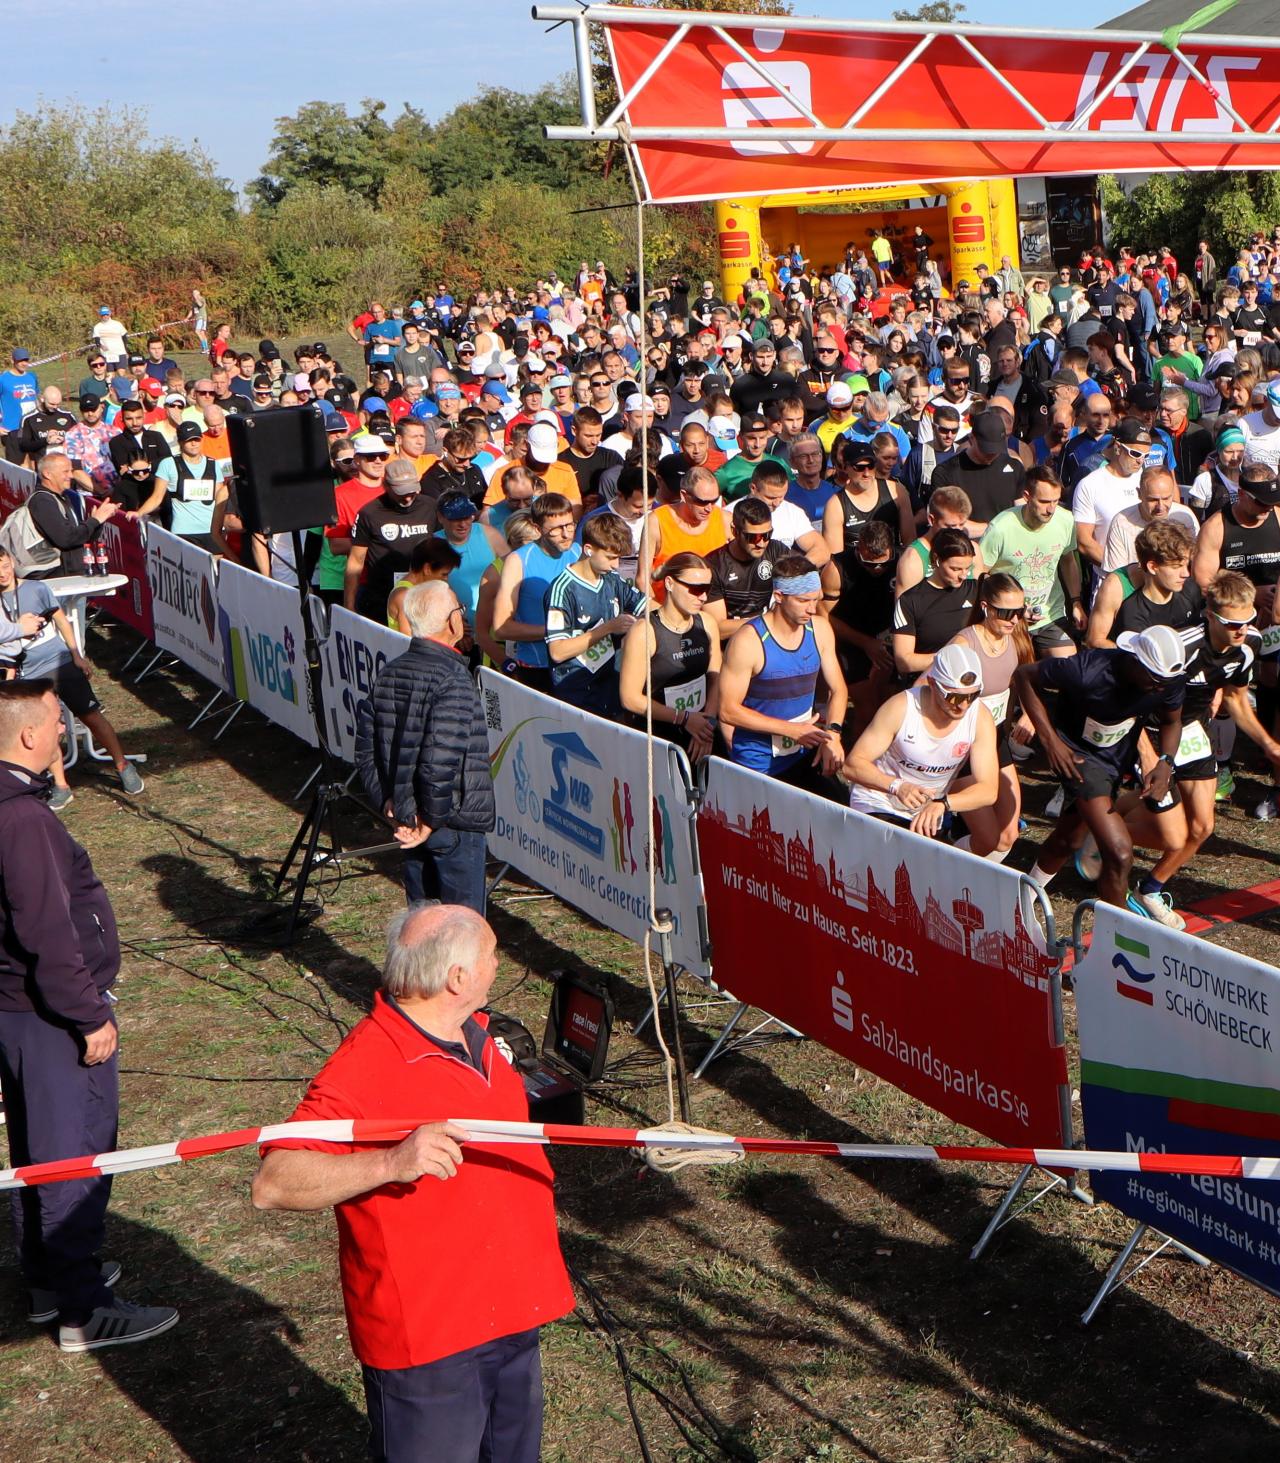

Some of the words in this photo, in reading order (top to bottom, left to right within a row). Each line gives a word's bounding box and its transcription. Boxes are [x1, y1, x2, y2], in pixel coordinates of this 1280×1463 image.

[953, 246, 986, 254] Sparkasse
[672, 646, 705, 661] newline
[674, 690, 702, 711] 847
[1092, 729, 1127, 743] 979
[496, 815, 515, 843] Der
[562, 848, 578, 878] für
[579, 863, 596, 895] alle
[722, 862, 744, 892] Wir
[746, 873, 769, 902] sind
[772, 886, 792, 916] hier
[795, 904, 809, 924] zu
[812, 903, 850, 946] Hause.
[851, 926, 879, 958] Seit
[881, 940, 919, 977] 1823.
[1162, 954, 1270, 1017] STADTWERKE
[1165, 989, 1273, 1053] SCHÖNEBECK
[860, 1014, 1030, 1127] Salzlandsparkasse
[1127, 1178, 1199, 1228] #regional
[1201, 1214, 1255, 1256] #stark
